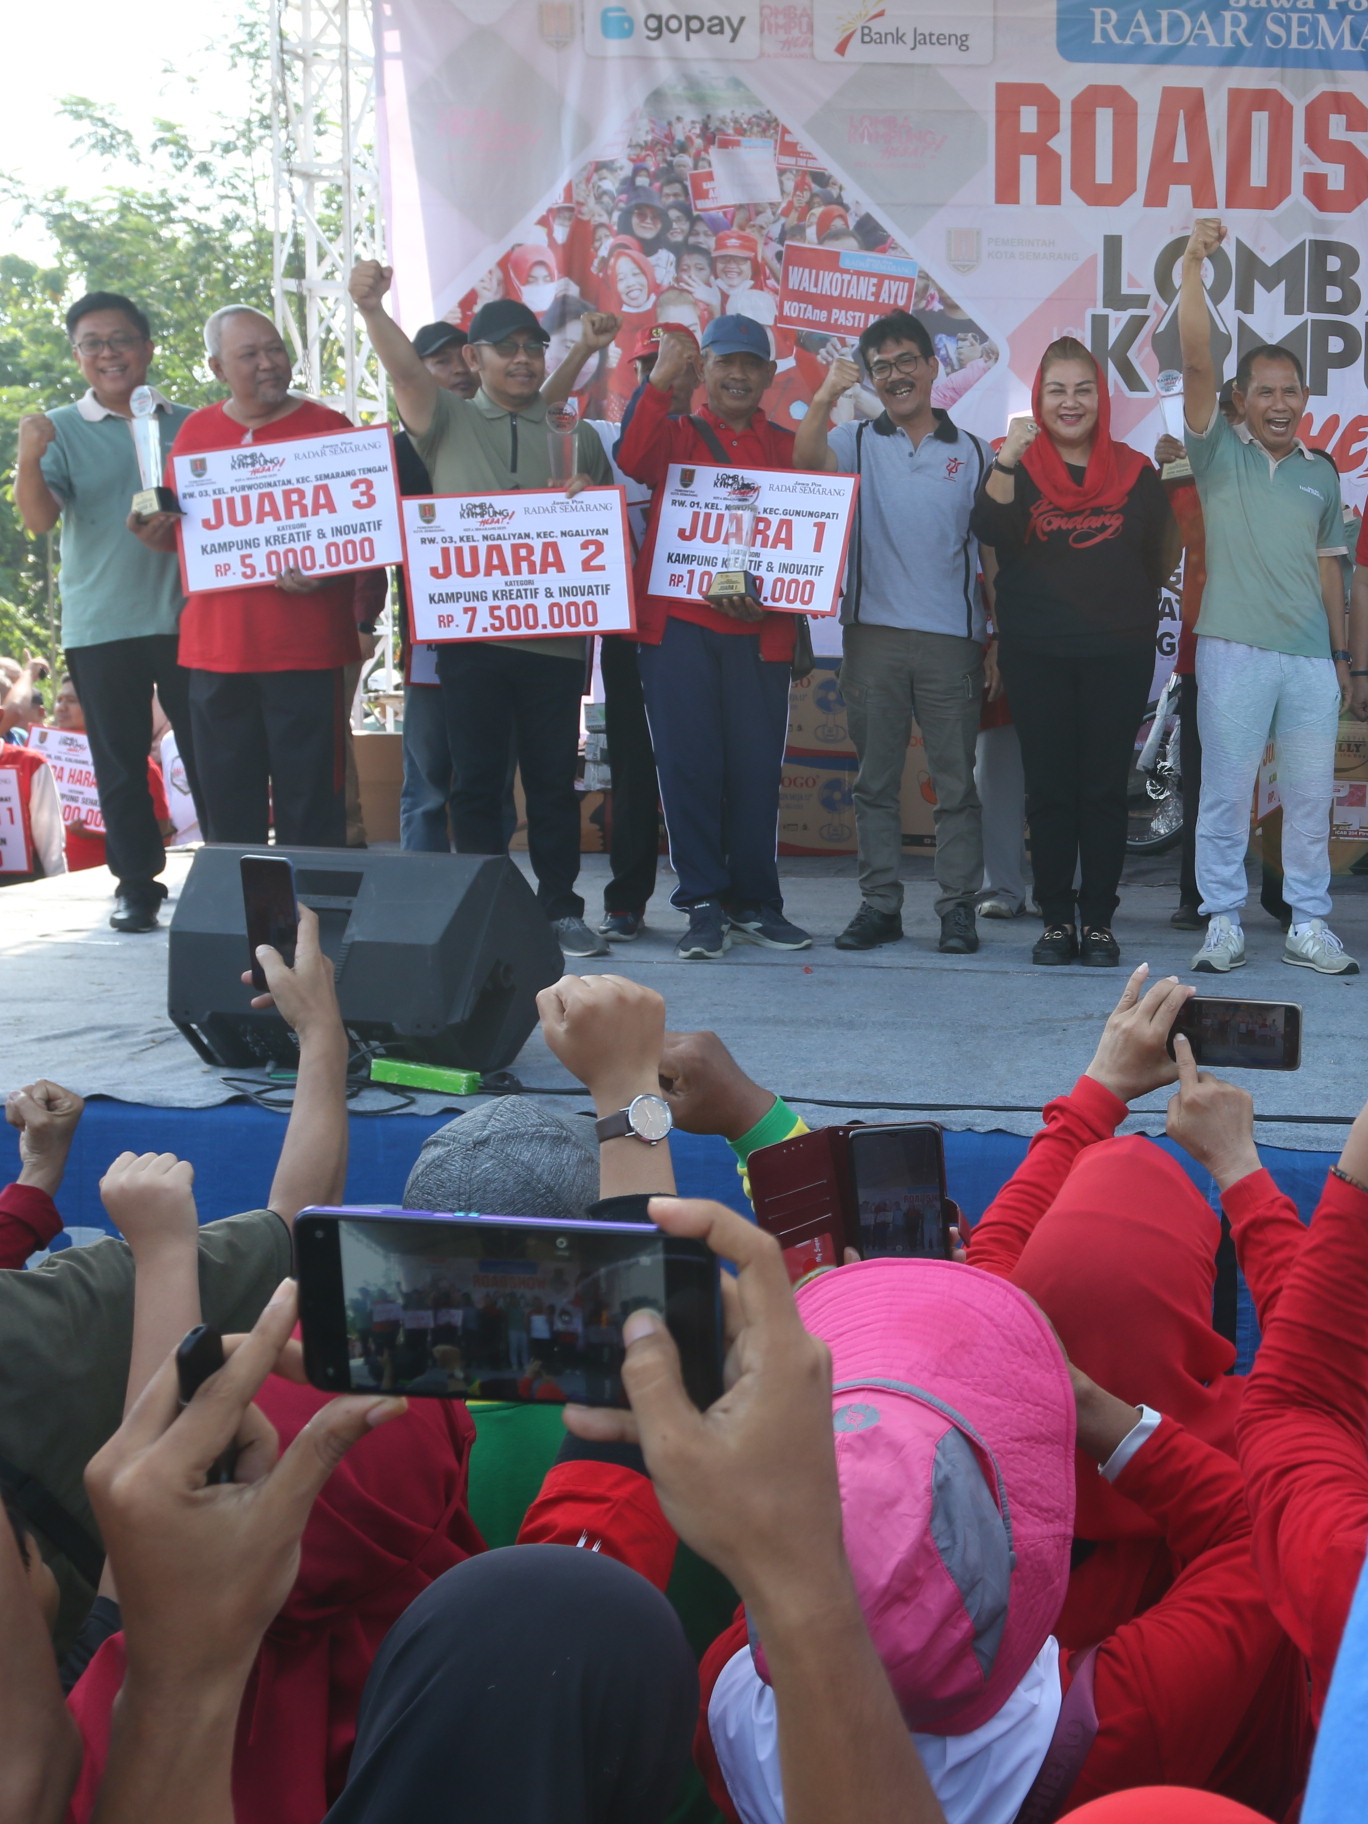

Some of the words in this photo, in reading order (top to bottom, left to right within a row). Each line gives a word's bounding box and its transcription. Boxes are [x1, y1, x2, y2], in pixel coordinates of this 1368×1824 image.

[644, 13, 746, 42] gopay
[860, 26, 906, 45] Bank
[911, 27, 970, 52] Jateng
[1091, 8, 1252, 47] RADAR
[987, 238, 1055, 247] PEMERINTAH
[1019, 252, 1079, 261] SEMARANG
[788, 266, 876, 305] WALIKOTANE
[879, 280, 909, 306] AYU
[783, 301, 827, 322] KOTAne
[831, 308, 865, 328] PASTI
[294, 450, 327, 461] RADAR
[329, 441, 381, 456] SEMARANG
[182, 490, 197, 500] RW.
[199, 489, 210, 498] 03,
[212, 486, 228, 496] KEL.
[230, 478, 294, 494] PURWODINATAN,
[296, 476, 313, 484] KEC.
[314, 470, 356, 482] SEMARANG
[358, 464, 388, 475] TENGAH
[768, 484, 798, 493] RADAR
[799, 486, 845, 497] SEMARANG
[202, 484, 337, 531] JUARA
[350, 478, 376, 510] 3
[460, 503, 495, 511] LOMBA
[524, 506, 557, 515] RADAR
[559, 503, 613, 513] SEMARANG
[671, 499, 688, 507] RW.
[689, 501, 702, 510] 01,
[704, 502, 723, 511] KEL.
[201, 536, 261, 555] KAMPUNG
[265, 529, 312, 547] KREATIF
[318, 528, 327, 539] &
[331, 519, 383, 537] INOVATIF
[277, 523, 307, 532] KATEGORI
[420, 537, 439, 545] RW.
[441, 536, 457, 544] 03,
[459, 534, 479, 543] KEL.
[482, 532, 534, 542] NGALIYAN,
[536, 530, 557, 539] KEC.
[561, 528, 609, 538] NGALIYAN
[677, 511, 793, 550] JUARA
[812, 521, 826, 552] 1
[215, 563, 236, 578] RP.
[240, 537, 375, 579] 5.000.000
[429, 541, 565, 580] JUARA
[580, 539, 605, 572] 2
[667, 552, 718, 567] KAMPUNG
[766, 562, 774, 572] &
[778, 562, 824, 577] INOVATIF
[505, 579, 535, 587] KATEGORI
[669, 573, 686, 588] RP.
[429, 590, 488, 605] KAMPUNG
[492, 587, 539, 601] KREATIF
[545, 587, 554, 598] &
[559, 584, 611, 598] INOVATIF
[438, 614, 459, 628] RP.
[463, 600, 598, 634] 7.500.000
